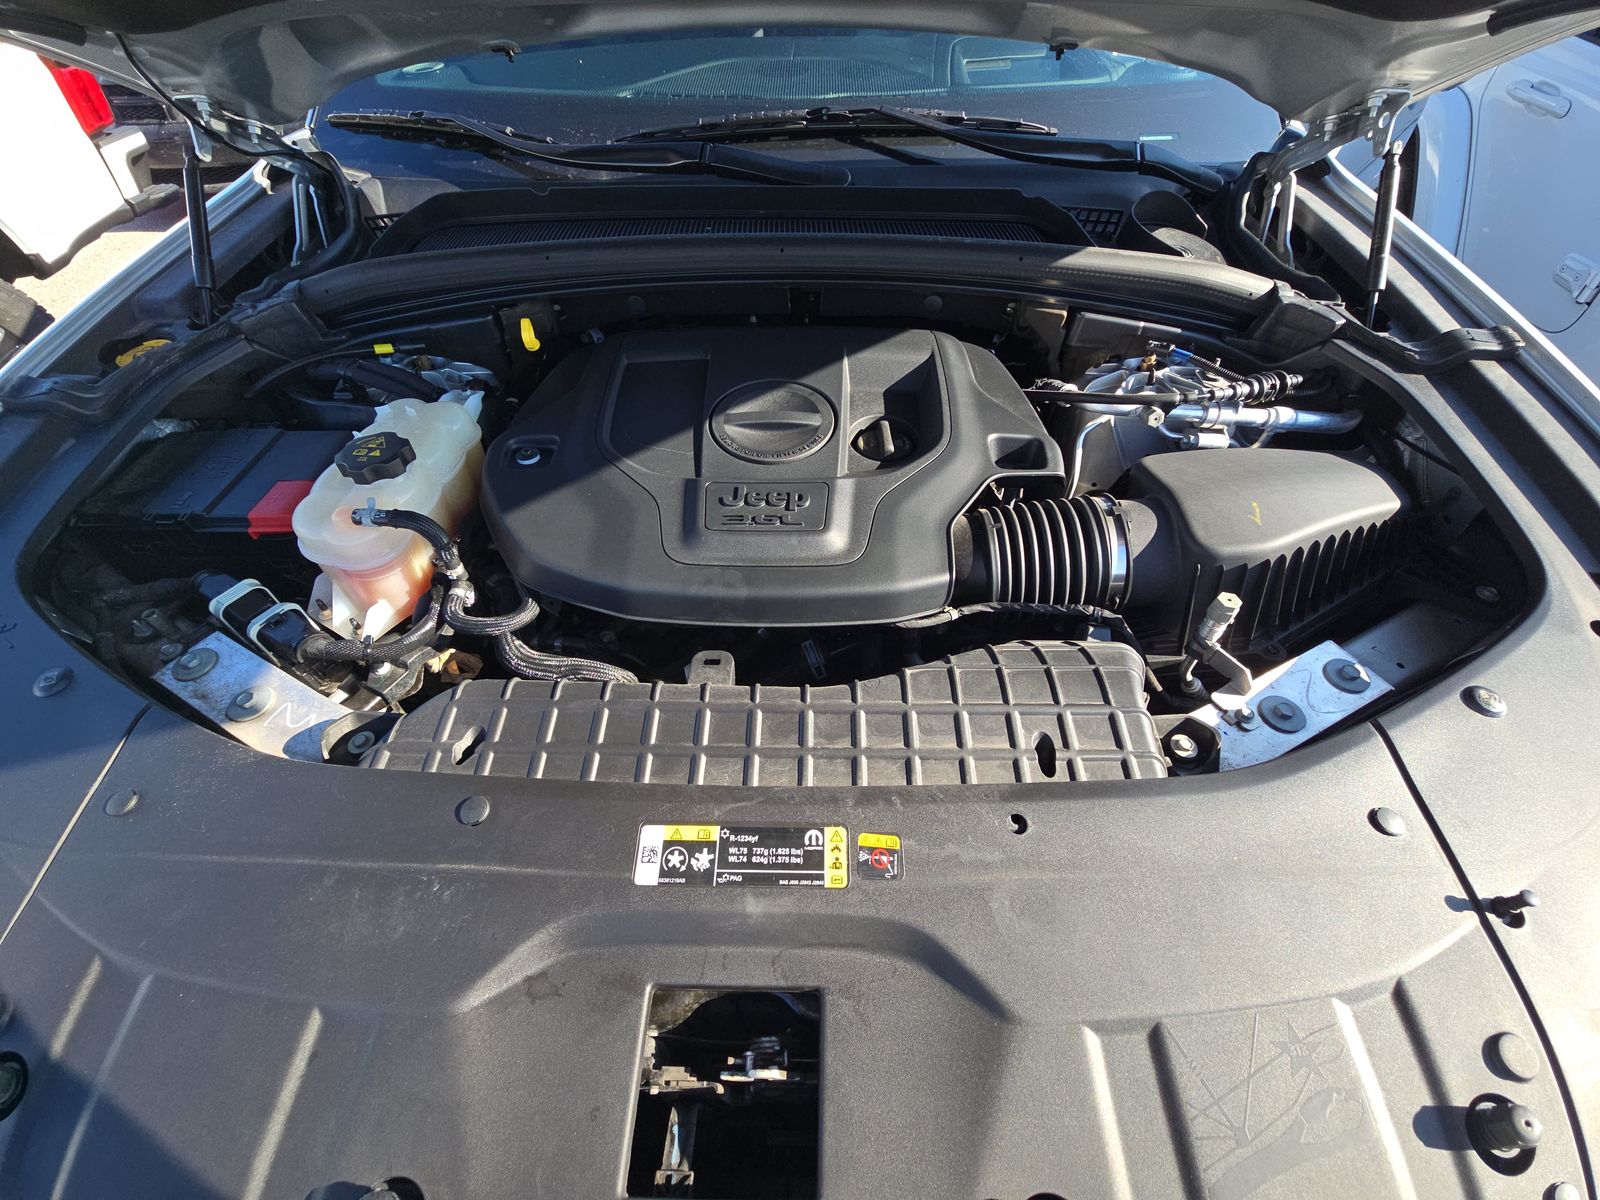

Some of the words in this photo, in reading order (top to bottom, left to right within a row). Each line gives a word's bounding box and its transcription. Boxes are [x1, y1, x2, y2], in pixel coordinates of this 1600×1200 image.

[718, 484, 811, 512] Jeep
[730, 835, 759, 843] R-1234yf
[752, 847, 769, 855] 737g
[769, 848, 790, 856] (1.625
[790, 848, 804, 856] lbs)
[728, 855, 747, 863] WL74
[751, 856, 768, 864] 624g
[769, 856, 790, 864] (1.375
[790, 856, 804, 865] lbs)
